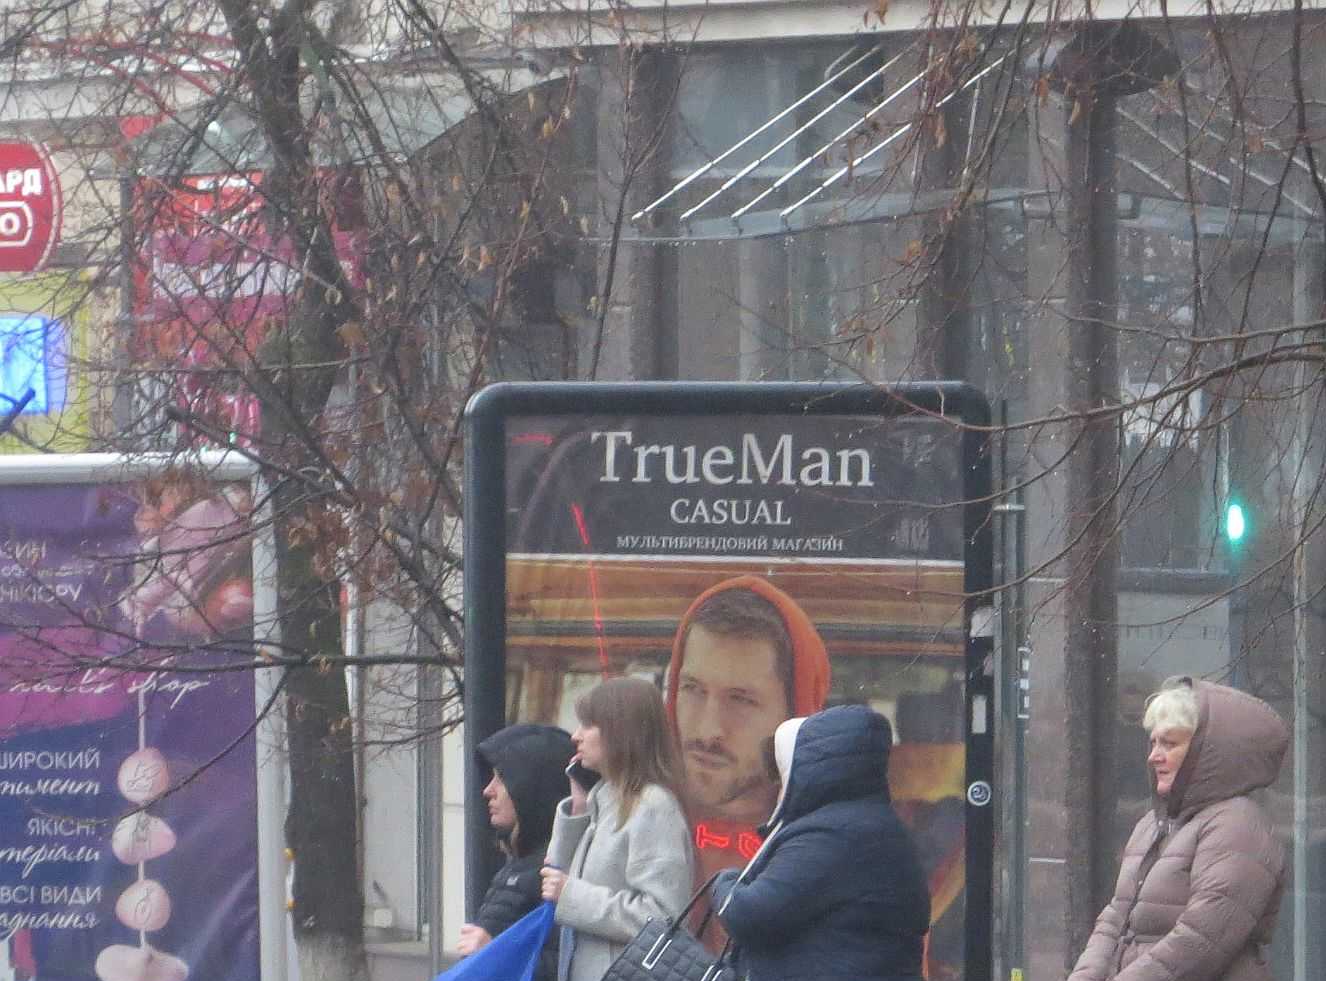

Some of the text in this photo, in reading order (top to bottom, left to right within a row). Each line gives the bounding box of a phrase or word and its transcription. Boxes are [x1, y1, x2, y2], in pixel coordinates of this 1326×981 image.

[591, 431, 875, 488] TrueMan
[669, 499, 792, 526] CASUAL
[615, 535, 843, 553] МУЛЬТИБРЕНДОВИЙ МАГАЗИН
[40, 885, 101, 905] ВИДИ
